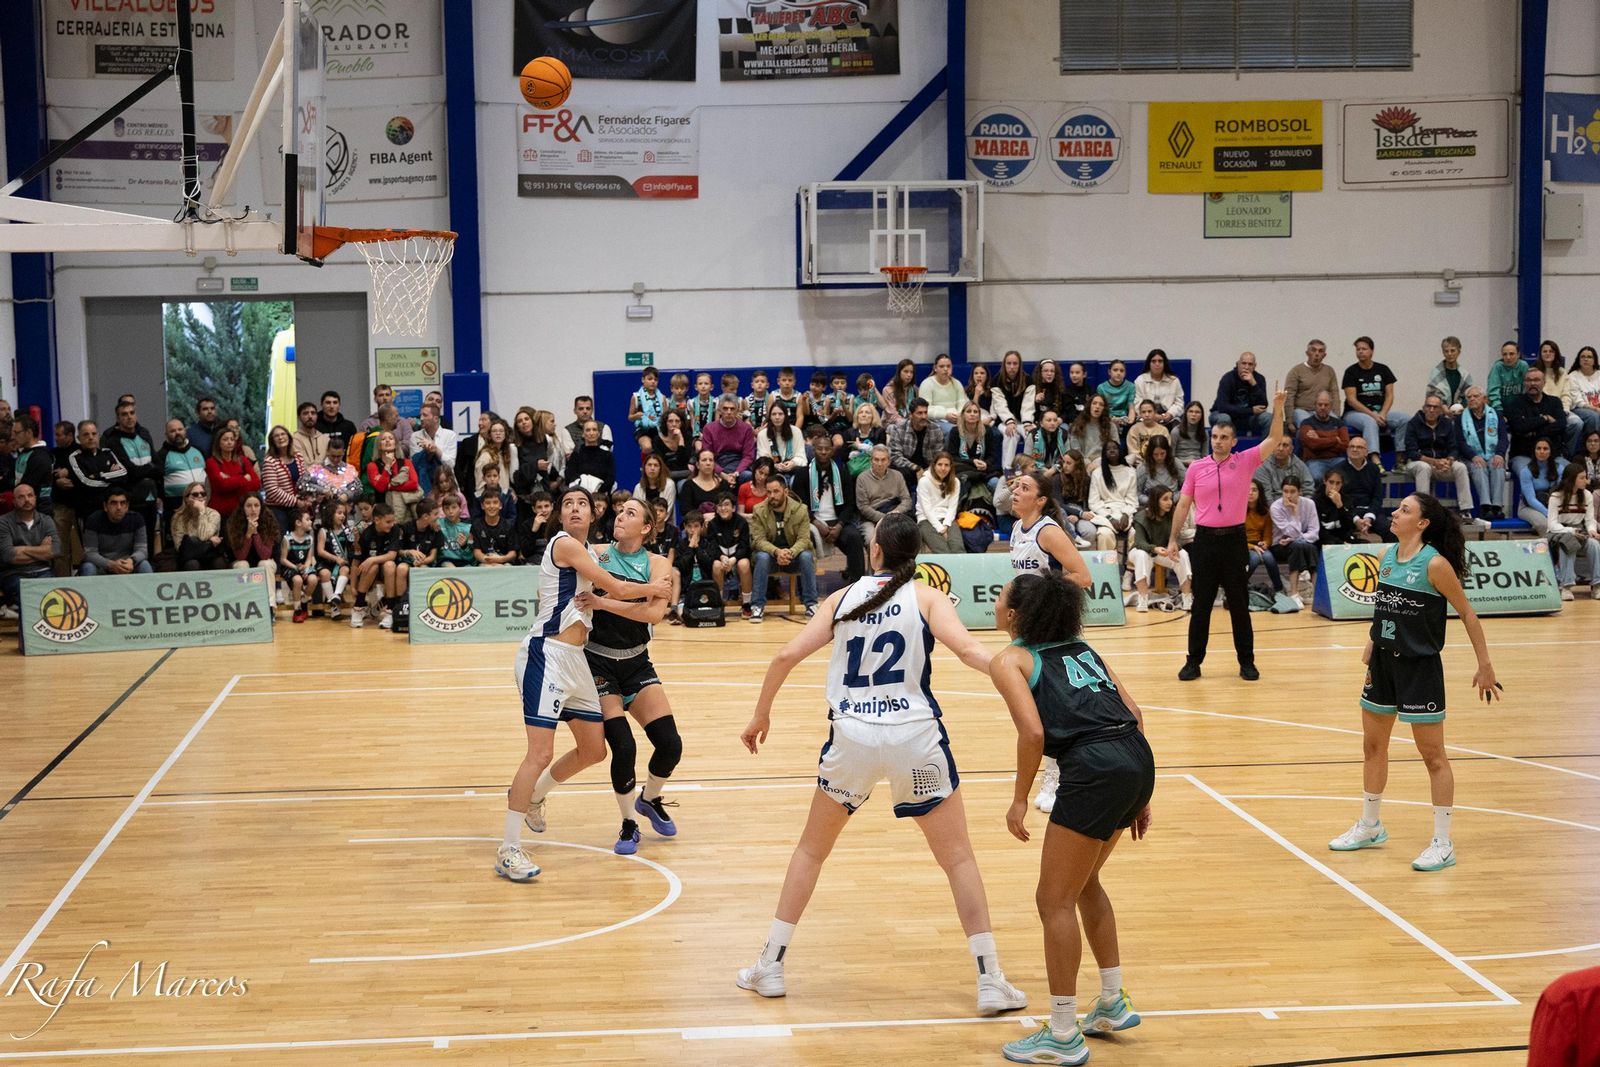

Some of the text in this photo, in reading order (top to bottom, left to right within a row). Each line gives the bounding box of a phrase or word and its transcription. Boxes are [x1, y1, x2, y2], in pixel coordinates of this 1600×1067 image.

[754, 5, 858, 26] TALLERES ABC
[56, 20, 225, 38] CERRAJERIA ESTONA
[322, 23, 410, 41] RADOR
[333, 42, 409, 51] AURANTE
[760, 42, 859, 55] MECANICA EN GENERAL
[327, 57, 374, 74] Pueblo
[744, 57, 828, 68] WWW.TALLERESABC.COM
[786, 67, 812, 75] ESTEPONA
[598, 114, 691, 127] Fernández Figares
[1215, 119, 1312, 133] ROMBOSOL
[598, 125, 658, 136] & Asociados
[980, 124, 1024, 136] RADIO
[1064, 125, 1107, 137] RADIO
[974, 139, 1030, 156] MARCA
[1058, 141, 1113, 157] MARCA
[1223, 149, 1312, 158] NUEVO SEMINUEVO
[1376, 149, 1423, 158] JARDINES
[1434, 146, 1476, 156] PISCINAS
[370, 150, 433, 165] FIBA Agent
[1223, 160, 1257, 168] OCASIÓN
[1159, 161, 1202, 170] RENAULT
[368, 173, 438, 187] www.jpsportsagency.com
[653, 183, 693, 191] info@ffya.es
[1237, 195, 1260, 203] PISTA
[1226, 207, 1271, 216] LEONARDO
[1216, 218, 1282, 228] TORRES BENÍTEZ
[1010, 556, 1040, 569] GANÉS
[1469, 551, 1501, 568] AB
[1463, 570, 1552, 590] EPONA
[156, 581, 213, 601] CAB
[1343, 586, 1377, 603] ESTEP
[111, 601, 263, 628] ESTEPONA
[422, 611, 479, 631] ESTEPONA
[35, 621, 96, 642] ESTEPONA
[124, 627, 255, 641] www.baloncestoestepona.com
[1381, 619, 1396, 640] 12
[842, 630, 906, 688] 12
[1061, 651, 1116, 692] 41
[553, 699, 560, 713] 9
